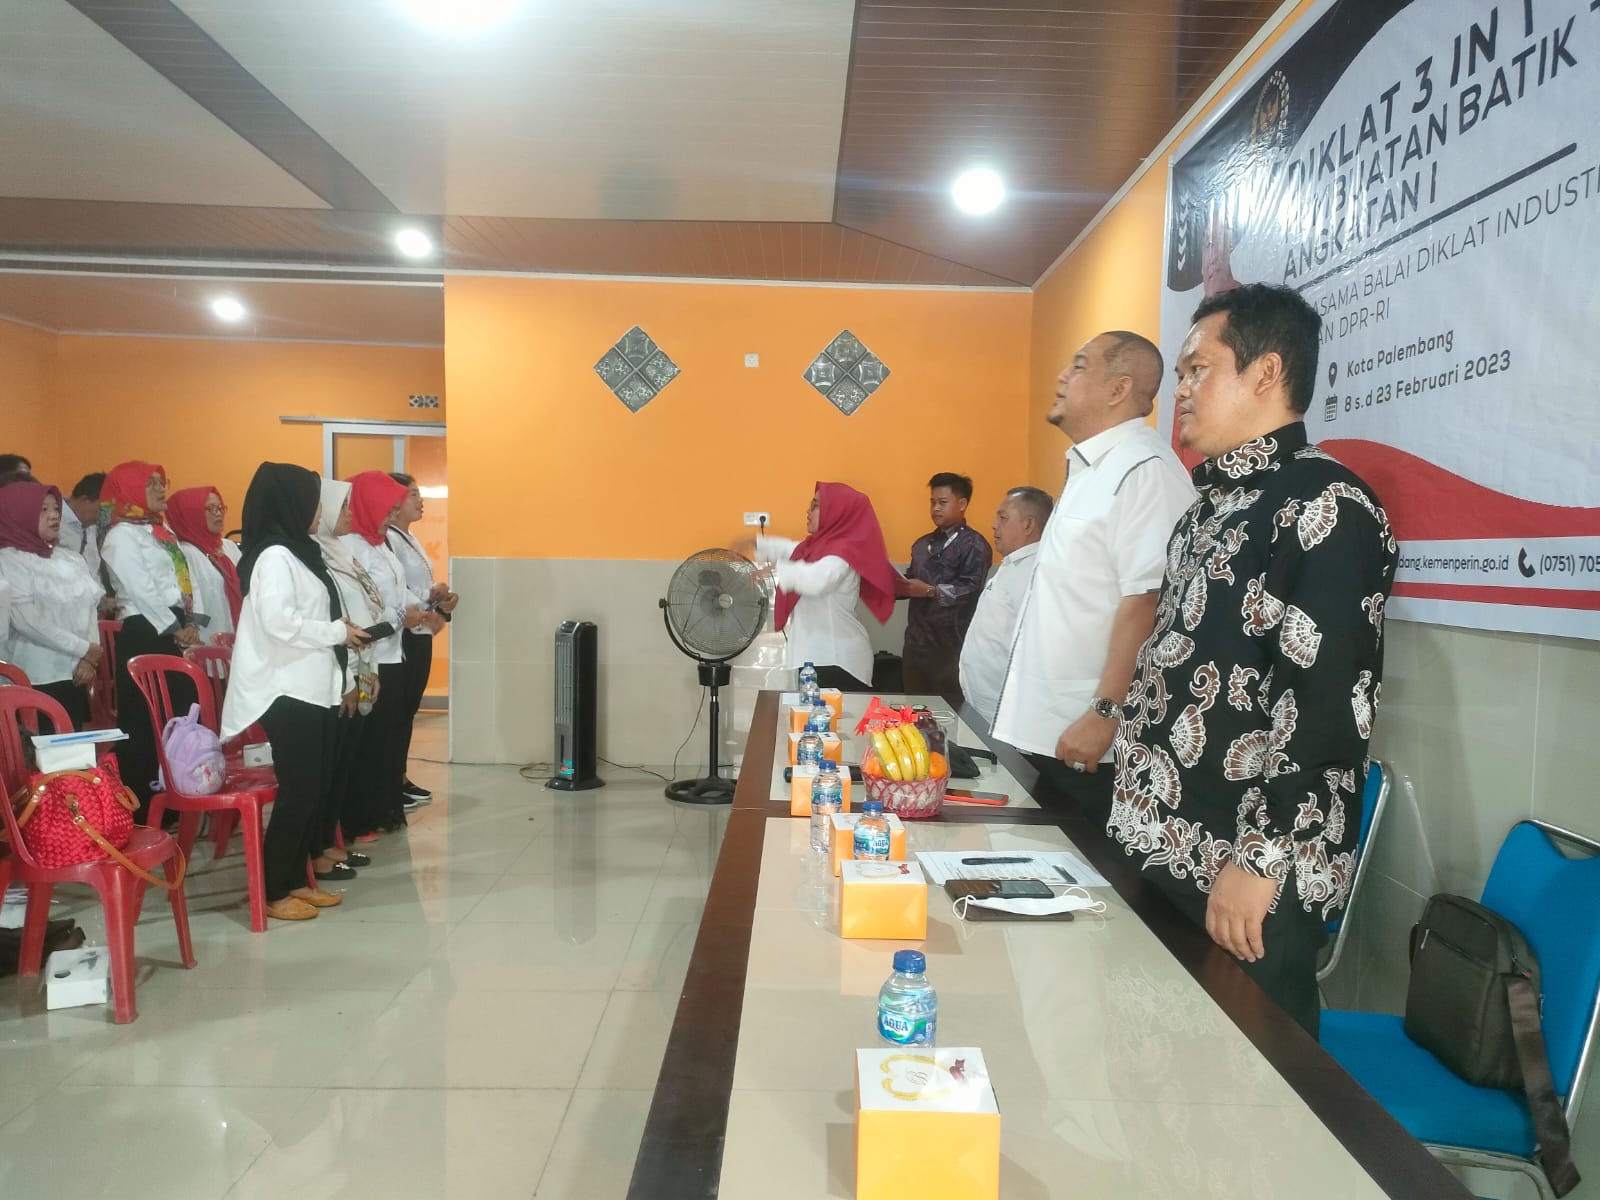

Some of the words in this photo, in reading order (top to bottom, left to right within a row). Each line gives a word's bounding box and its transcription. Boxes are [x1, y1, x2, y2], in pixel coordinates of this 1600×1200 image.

[1412, 55, 1433, 113] 3
[1450, 6, 1498, 88] IN
[1459, 14, 1578, 135] BATIK
[1429, 161, 1437, 203] I
[1364, 255, 1410, 296] BALAI
[1417, 217, 1489, 272] DIKLAT
[1497, 165, 1600, 237] INDUST
[1339, 297, 1390, 338] DPR-RI
[1344, 396, 1351, 412] 8
[1355, 389, 1373, 410] s.d
[1376, 384, 1392, 404] 23
[1396, 364, 1459, 399] Februari
[1464, 350, 1511, 381] 2023
[1346, 358, 1374, 378] Kota
[1377, 329, 1454, 368] Palembang
[1540, 554, 1575, 576] (0751)
